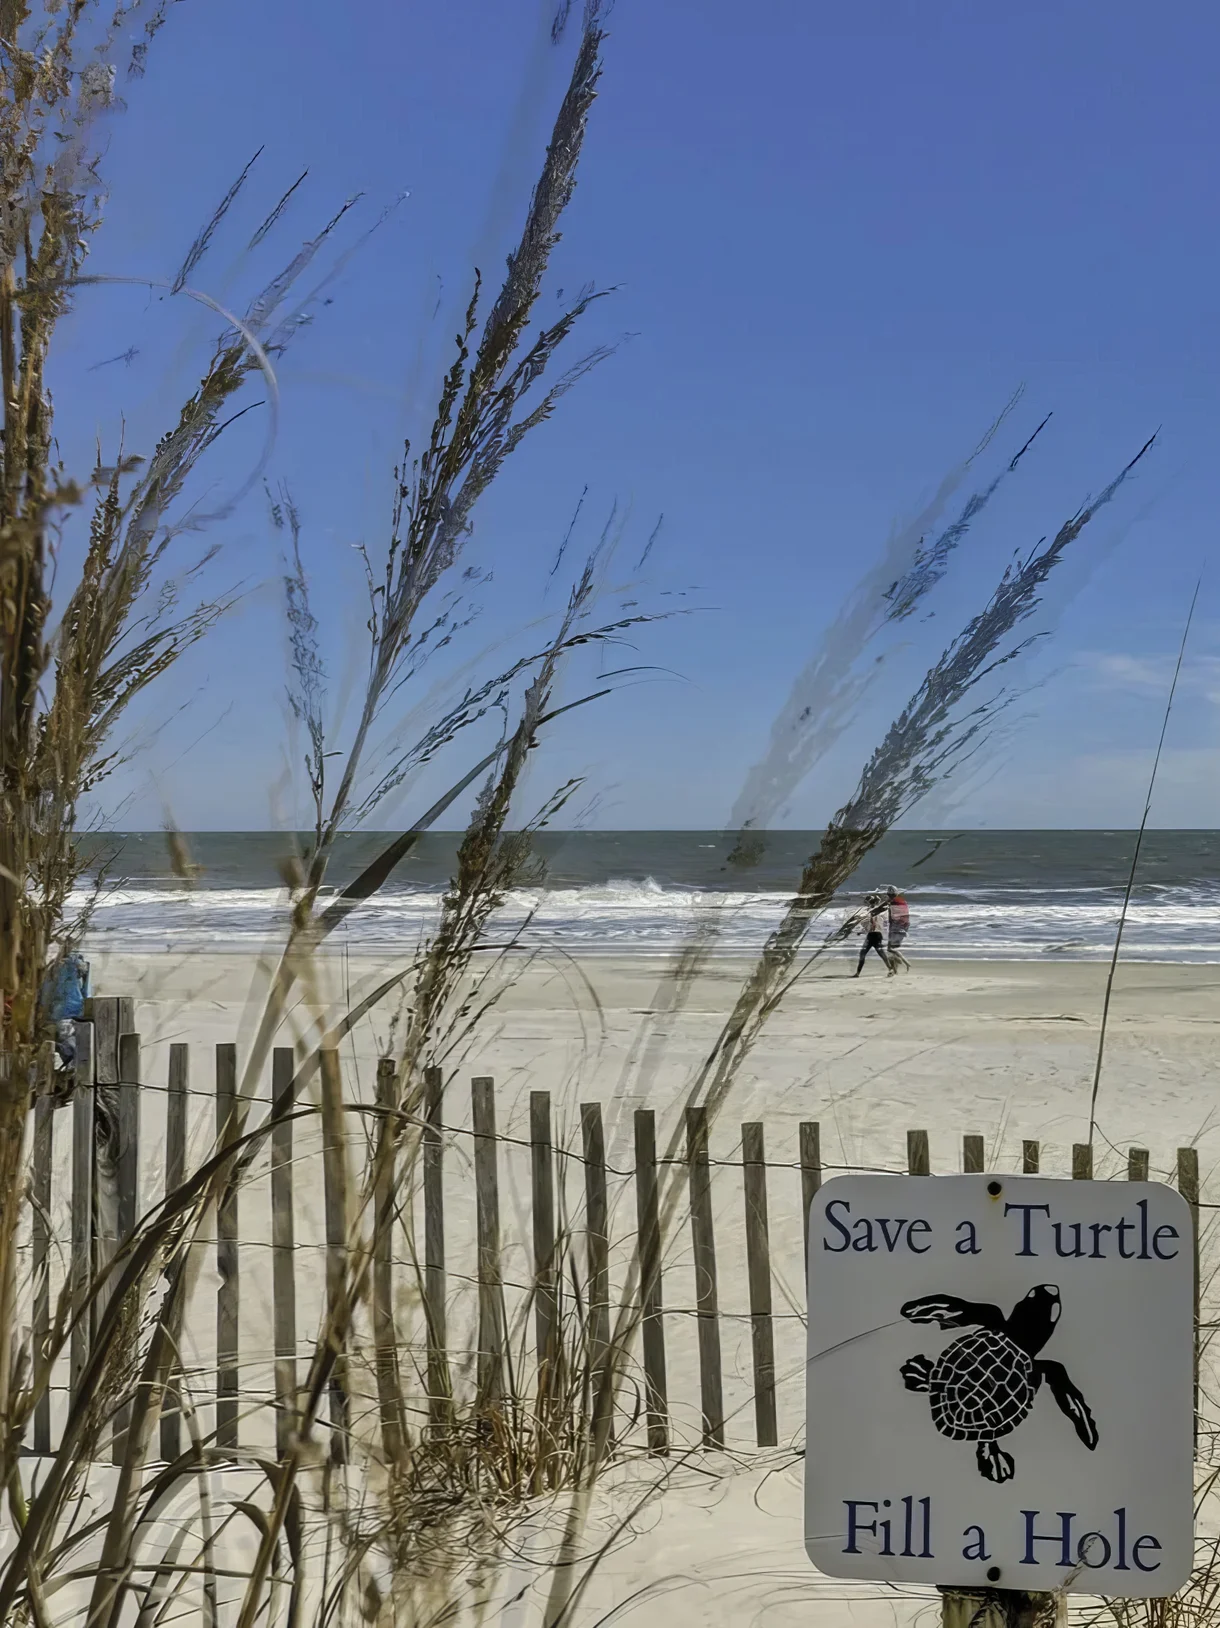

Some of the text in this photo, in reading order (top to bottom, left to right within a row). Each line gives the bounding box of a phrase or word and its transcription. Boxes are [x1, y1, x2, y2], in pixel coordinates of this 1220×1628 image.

[823, 1199, 1180, 1260] Save a Turtle
[841, 1495, 1163, 1572] Fill a Hole
